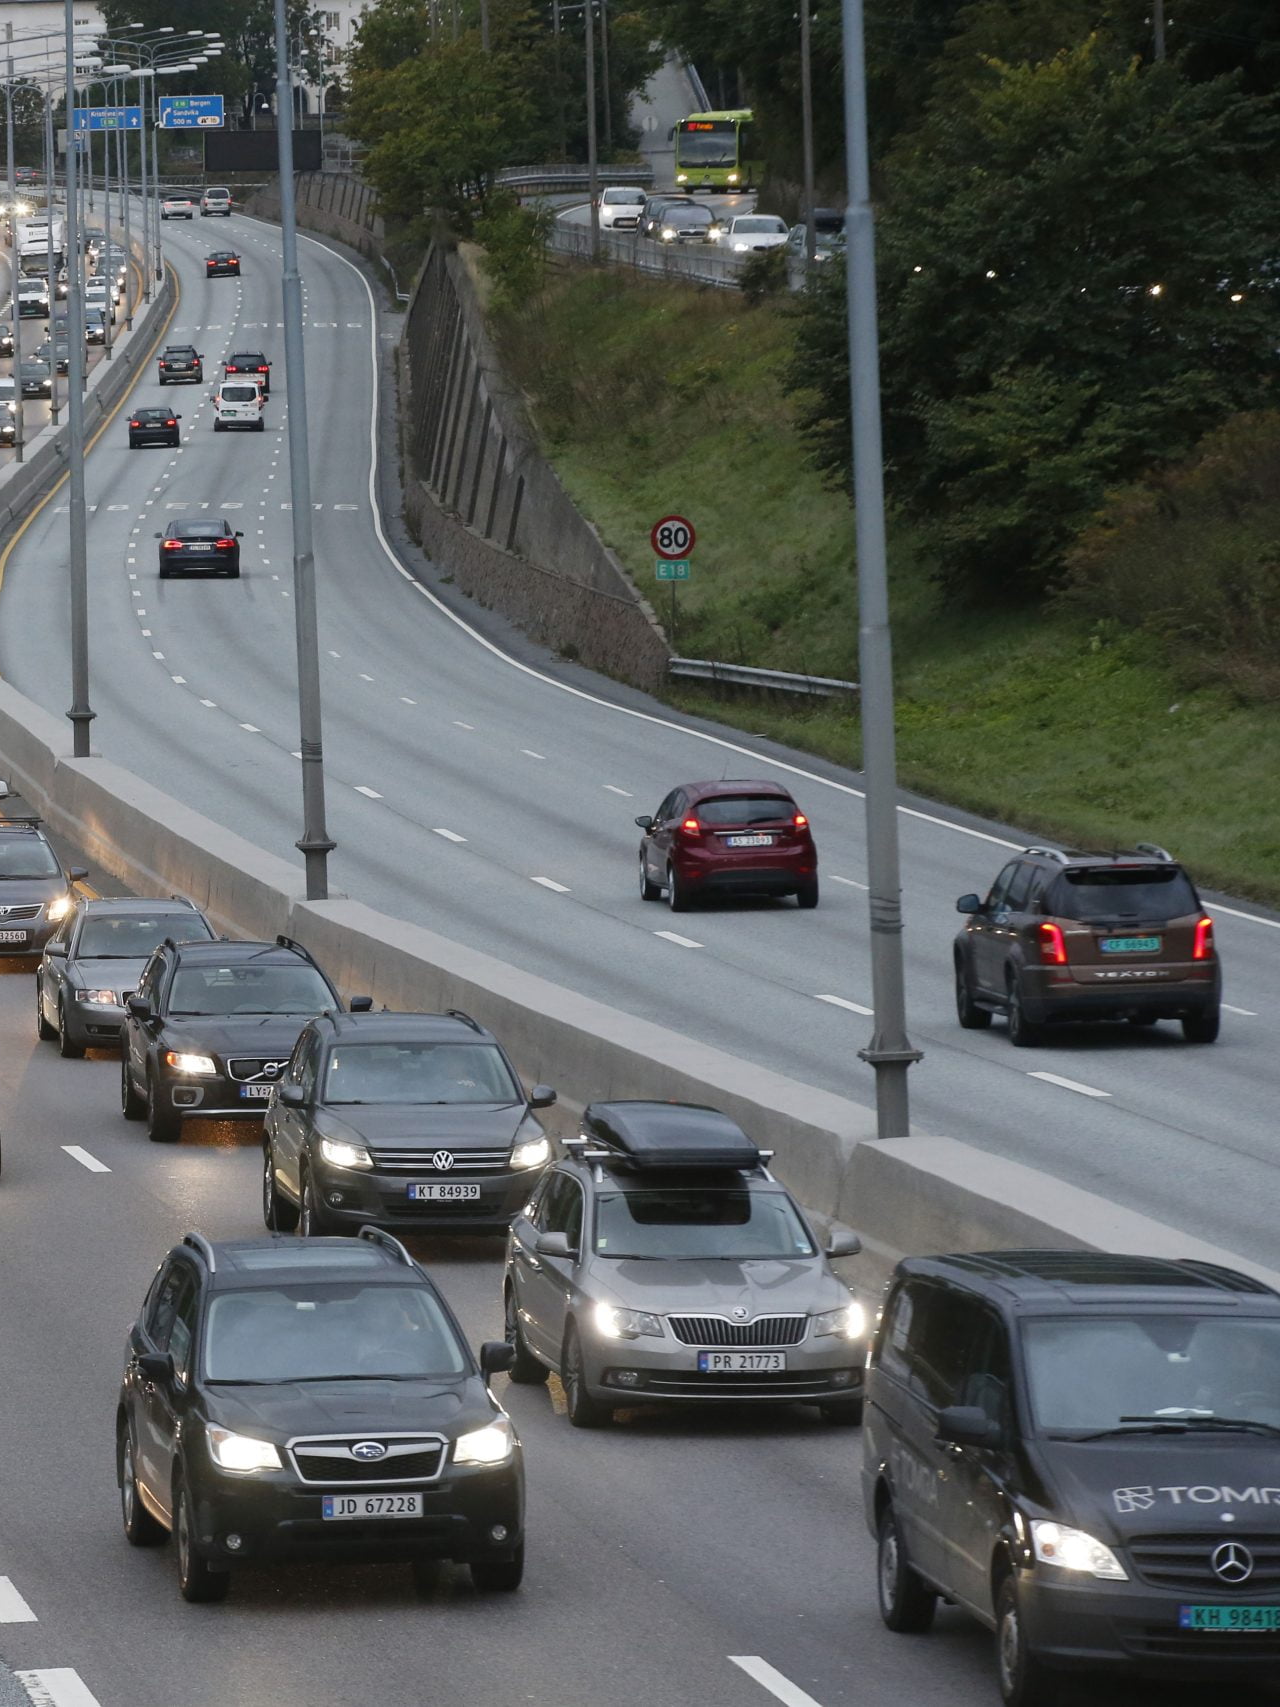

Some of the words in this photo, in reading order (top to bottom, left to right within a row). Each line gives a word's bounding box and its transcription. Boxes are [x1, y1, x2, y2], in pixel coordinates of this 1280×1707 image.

[660, 527, 688, 548] 80
[660, 565, 667, 576] E
[670, 565, 685, 576] 18
[0, 932, 25, 940] 32560
[249, 1086, 262, 1096] LY
[419, 1186, 434, 1197] KT
[440, 1186, 477, 1197] 84939
[714, 1356, 732, 1368] PR
[740, 1355, 780, 1368] 21773
[339, 1499, 357, 1514] JD
[365, 1497, 416, 1513] 67228
[1194, 1610, 1220, 1625] KH
[1229, 1609, 1280, 1625] 98418
